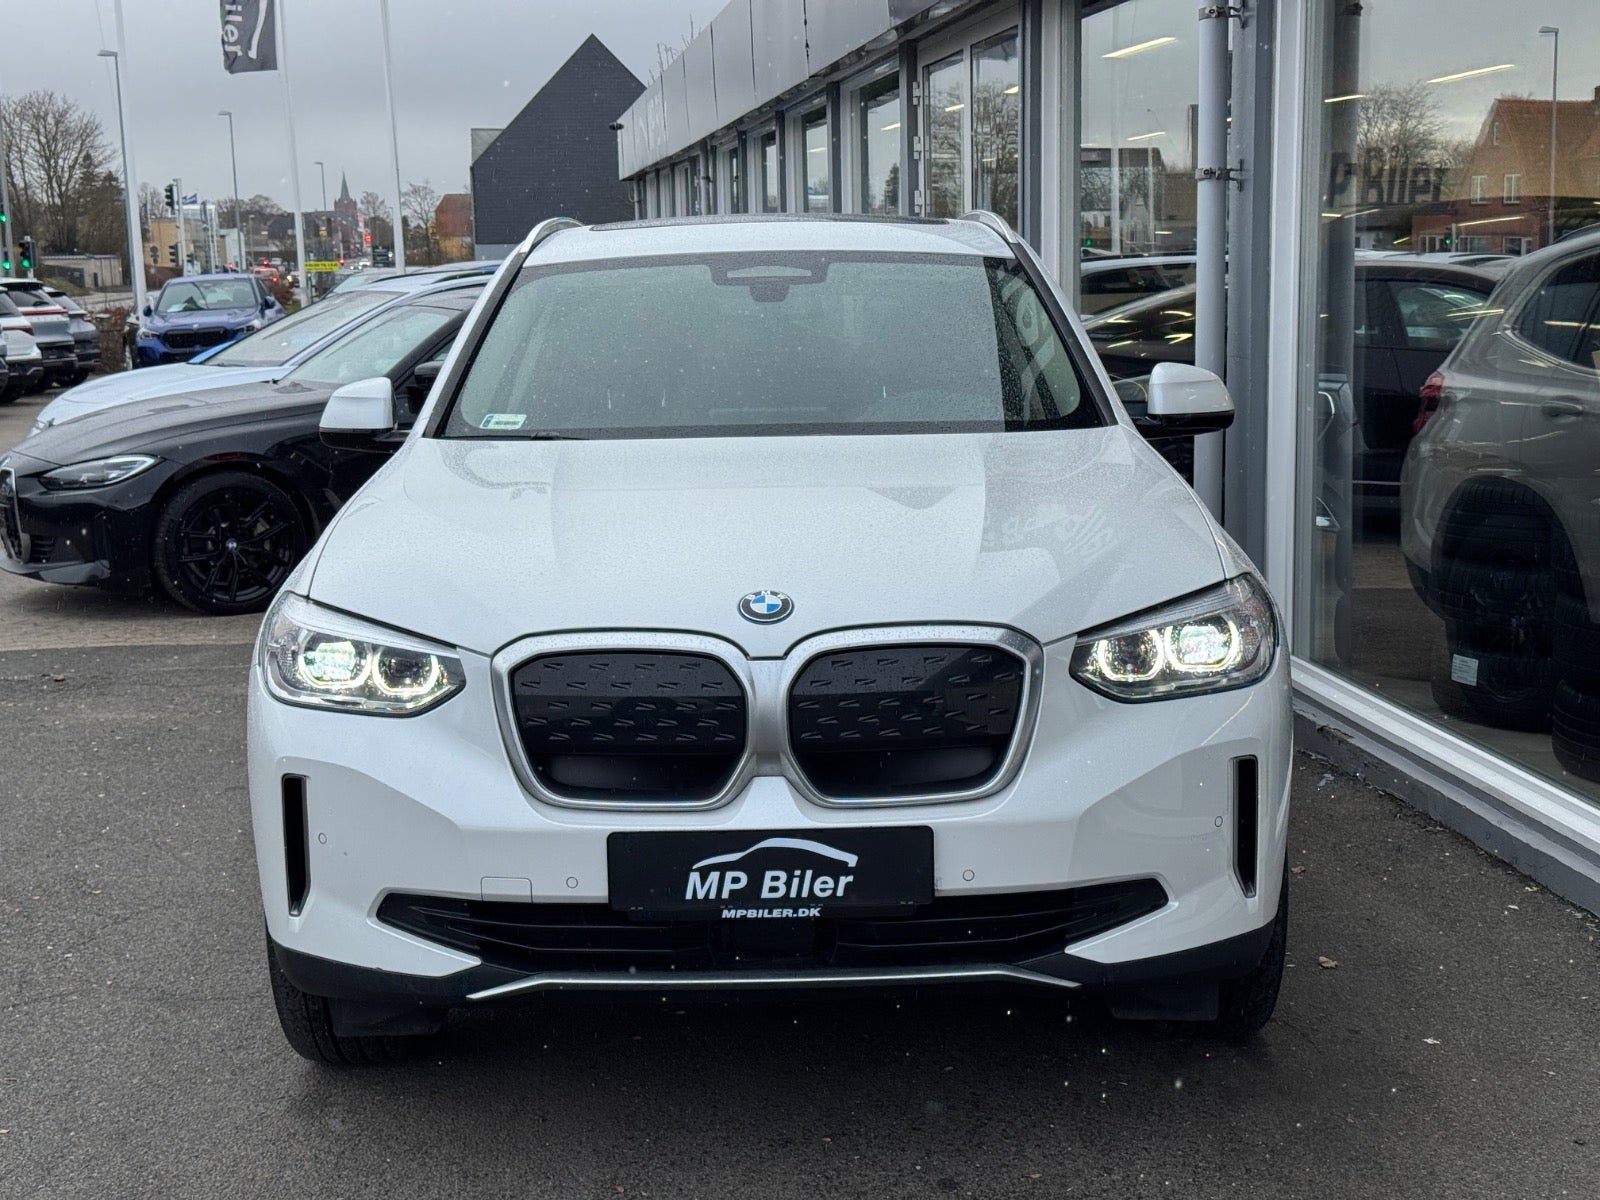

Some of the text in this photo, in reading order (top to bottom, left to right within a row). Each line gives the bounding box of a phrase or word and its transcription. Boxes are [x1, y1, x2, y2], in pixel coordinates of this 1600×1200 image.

[685, 869, 854, 900] MP Biler
[721, 907, 822, 919] MPBILER.DK
